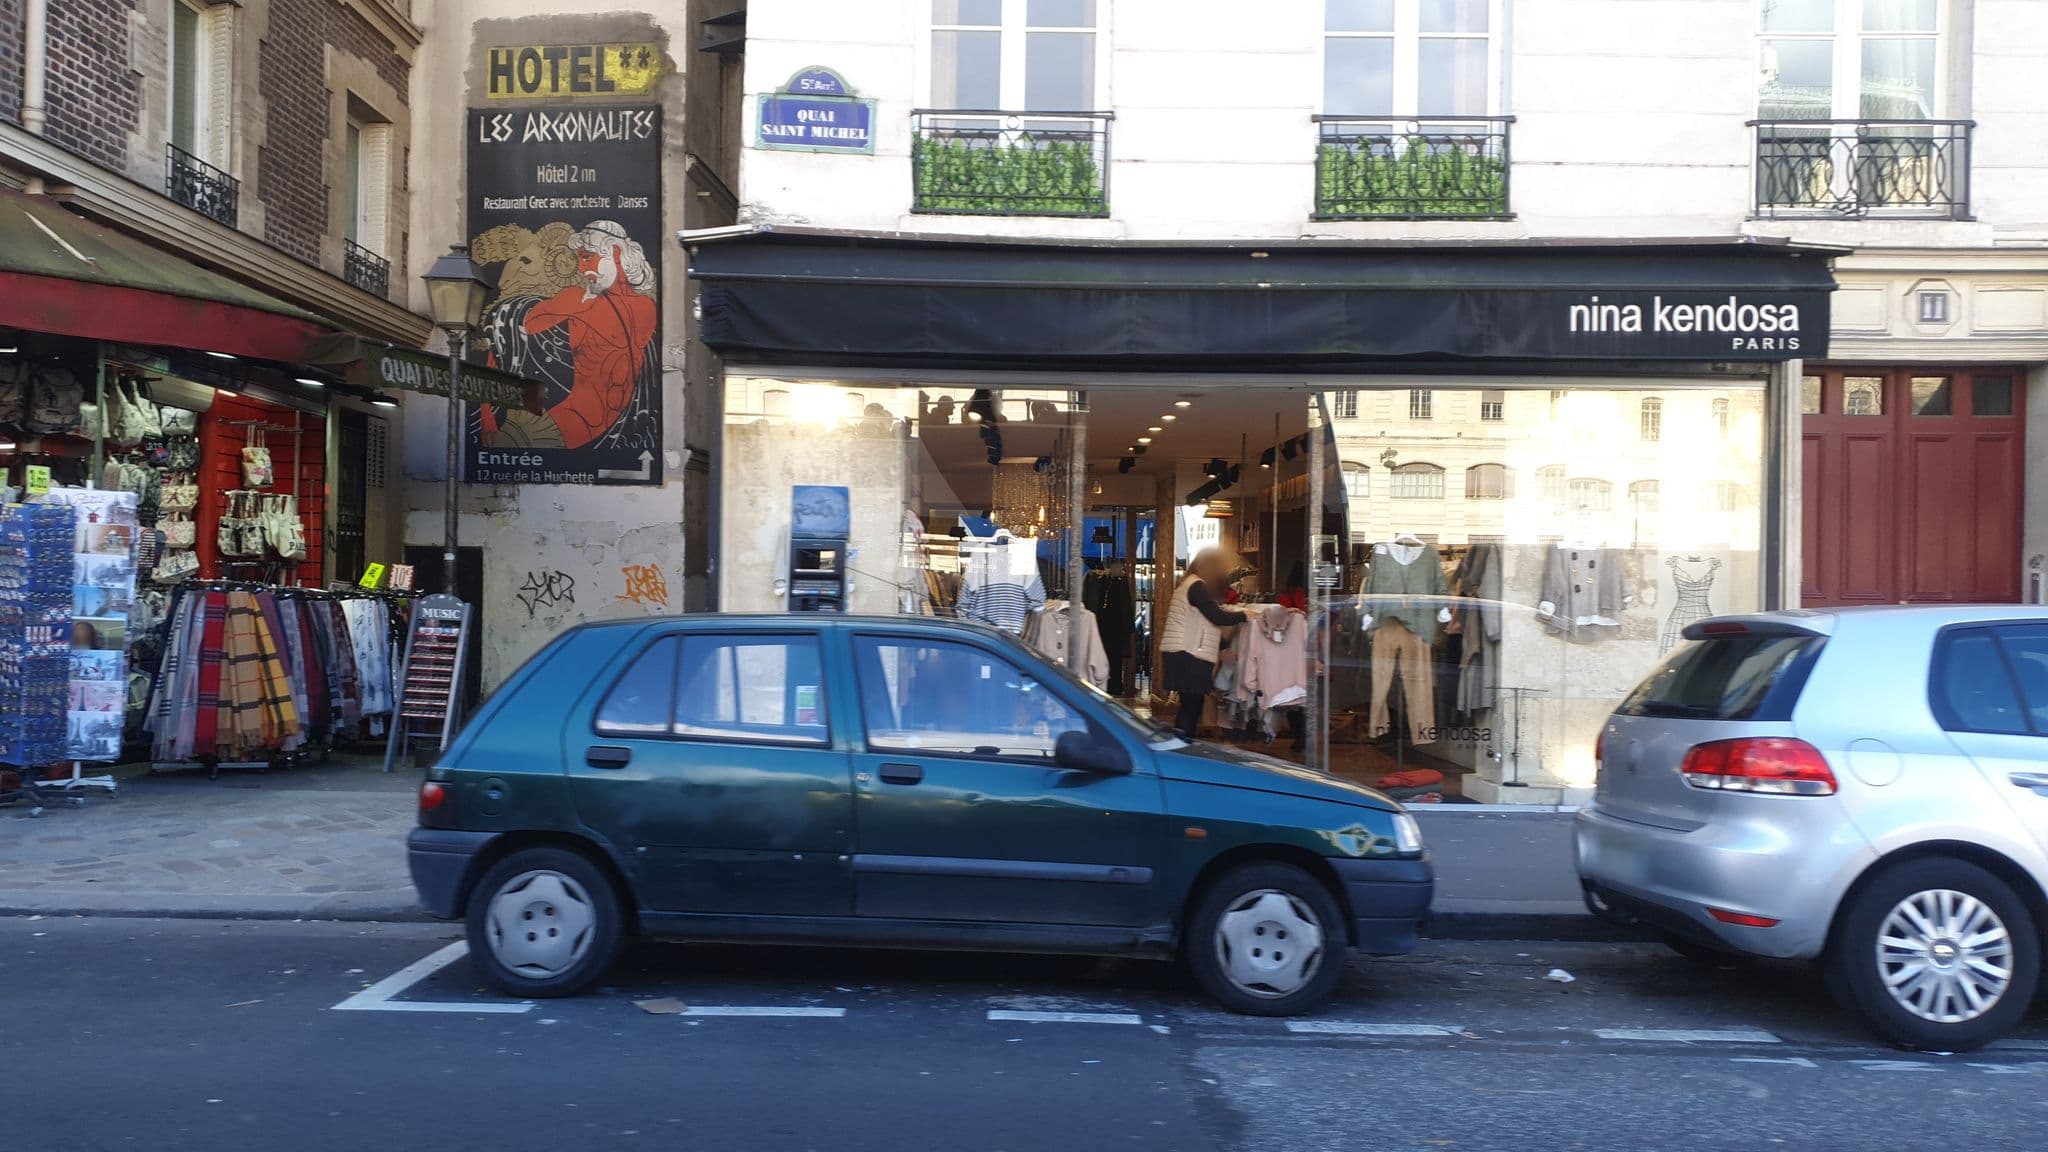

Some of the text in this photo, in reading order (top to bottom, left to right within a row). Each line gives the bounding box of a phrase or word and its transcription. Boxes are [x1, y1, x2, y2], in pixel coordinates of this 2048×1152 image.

[489, 46, 615, 94] HOTEL
[797, 109, 835, 122] QUAI
[480, 110, 655, 143] LES ARGONAUTES
[762, 123, 869, 140] SAINT MICHEL
[537, 164, 568, 183] Hôtel
[570, 165, 578, 183] 2
[484, 195, 648, 210] Restaurant Grec avec orchestre Danses
[1569, 296, 1800, 333] nina kendosa
[1732, 337, 1800, 350] PARIS
[381, 356, 421, 388] QUAI
[478, 451, 544, 466] Entrée
[493, 471, 512, 481] rue
[514, 469, 528, 481] de
[531, 470, 541, 482] la
[544, 471, 595, 484] Huchette
[422, 607, 461, 619] MUSIC
